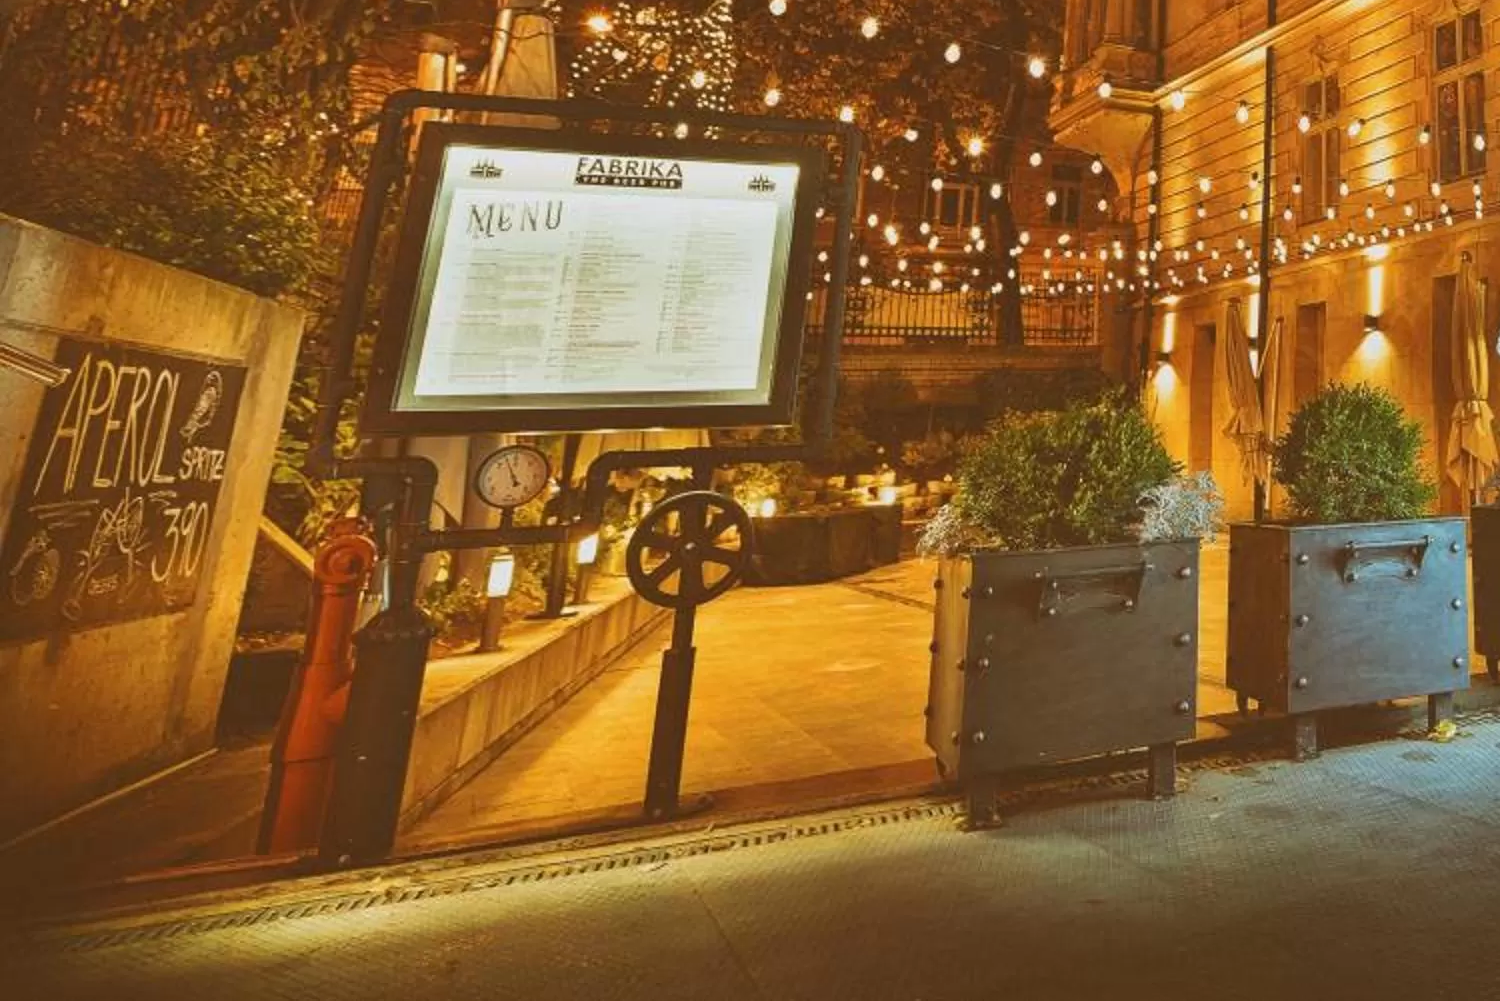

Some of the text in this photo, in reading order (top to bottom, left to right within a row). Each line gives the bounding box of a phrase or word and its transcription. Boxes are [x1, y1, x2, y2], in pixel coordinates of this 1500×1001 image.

[577, 157, 682, 177] FABRIKA
[466, 199, 563, 239] MENU
[33, 351, 181, 496] APEROL
